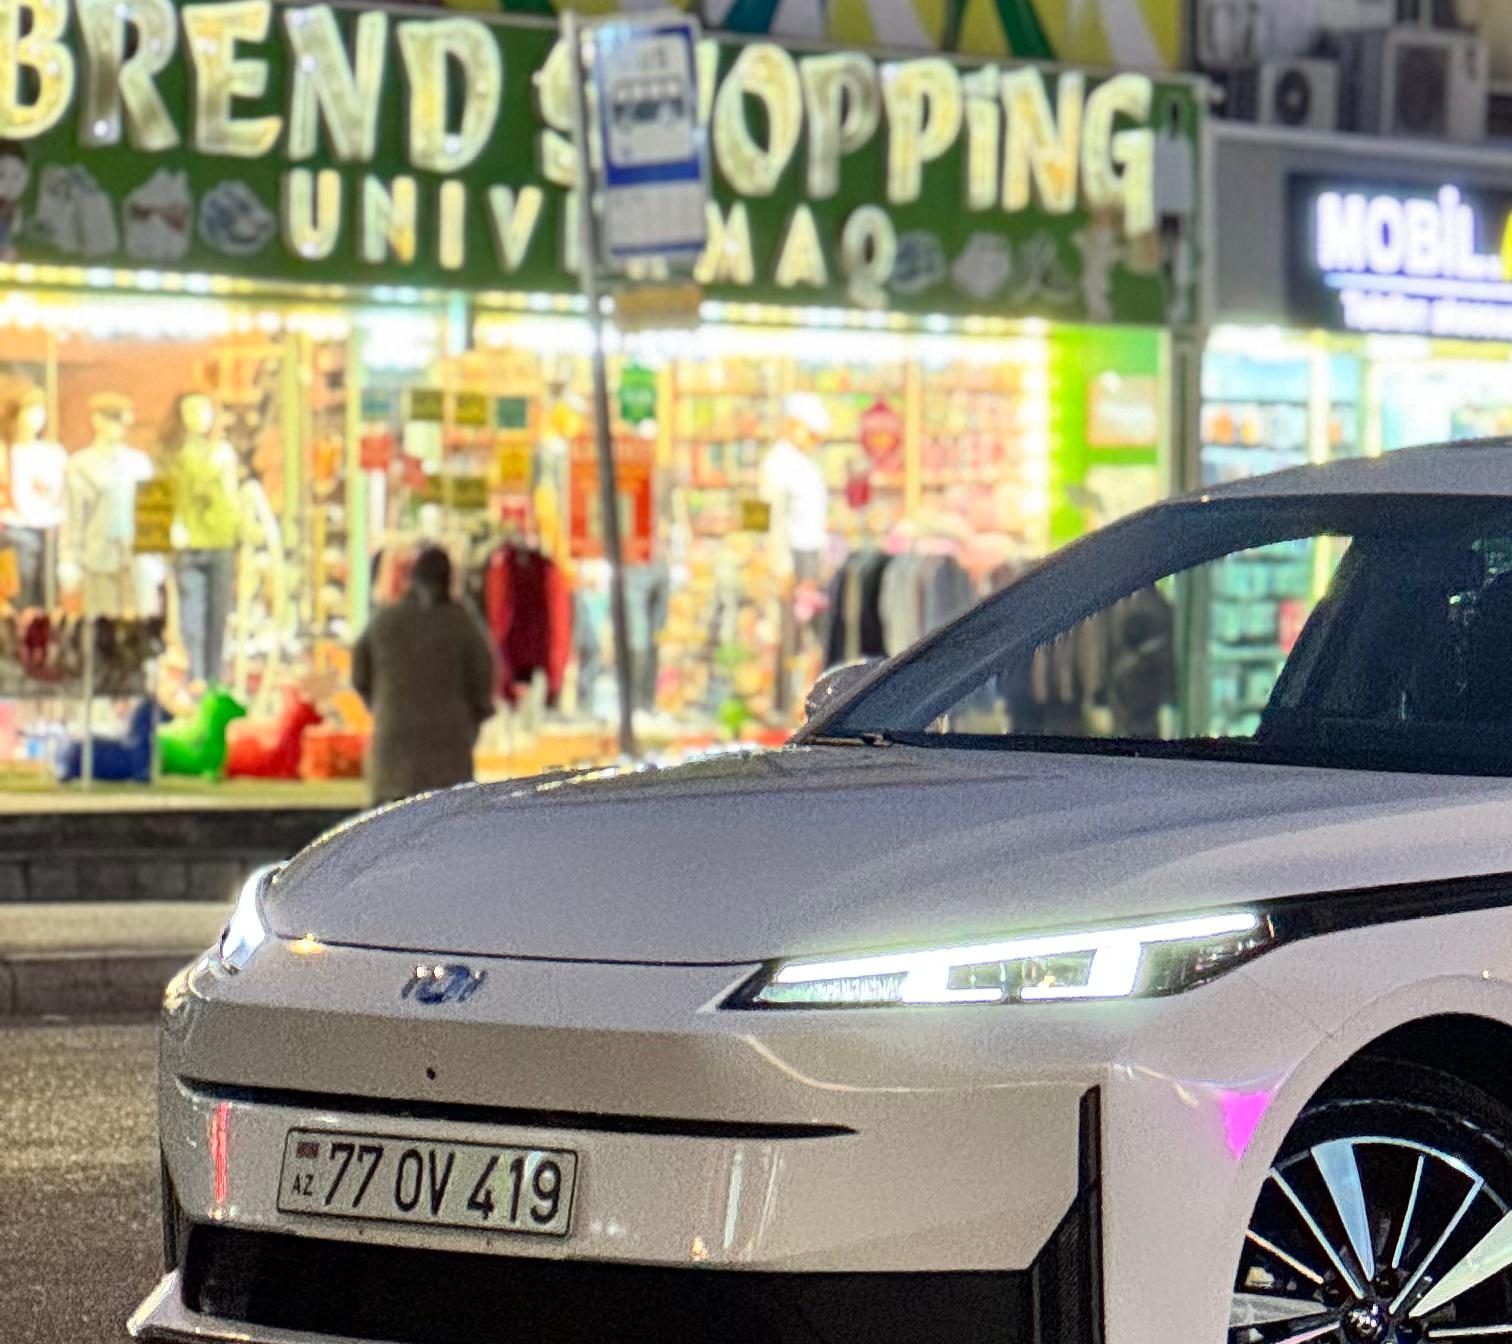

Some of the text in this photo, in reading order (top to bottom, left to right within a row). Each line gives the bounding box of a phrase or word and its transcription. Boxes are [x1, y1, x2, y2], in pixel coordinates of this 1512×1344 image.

[291, 1173, 314, 1196] AZ
[324, 1141, 562, 1224] 77 OV 419
